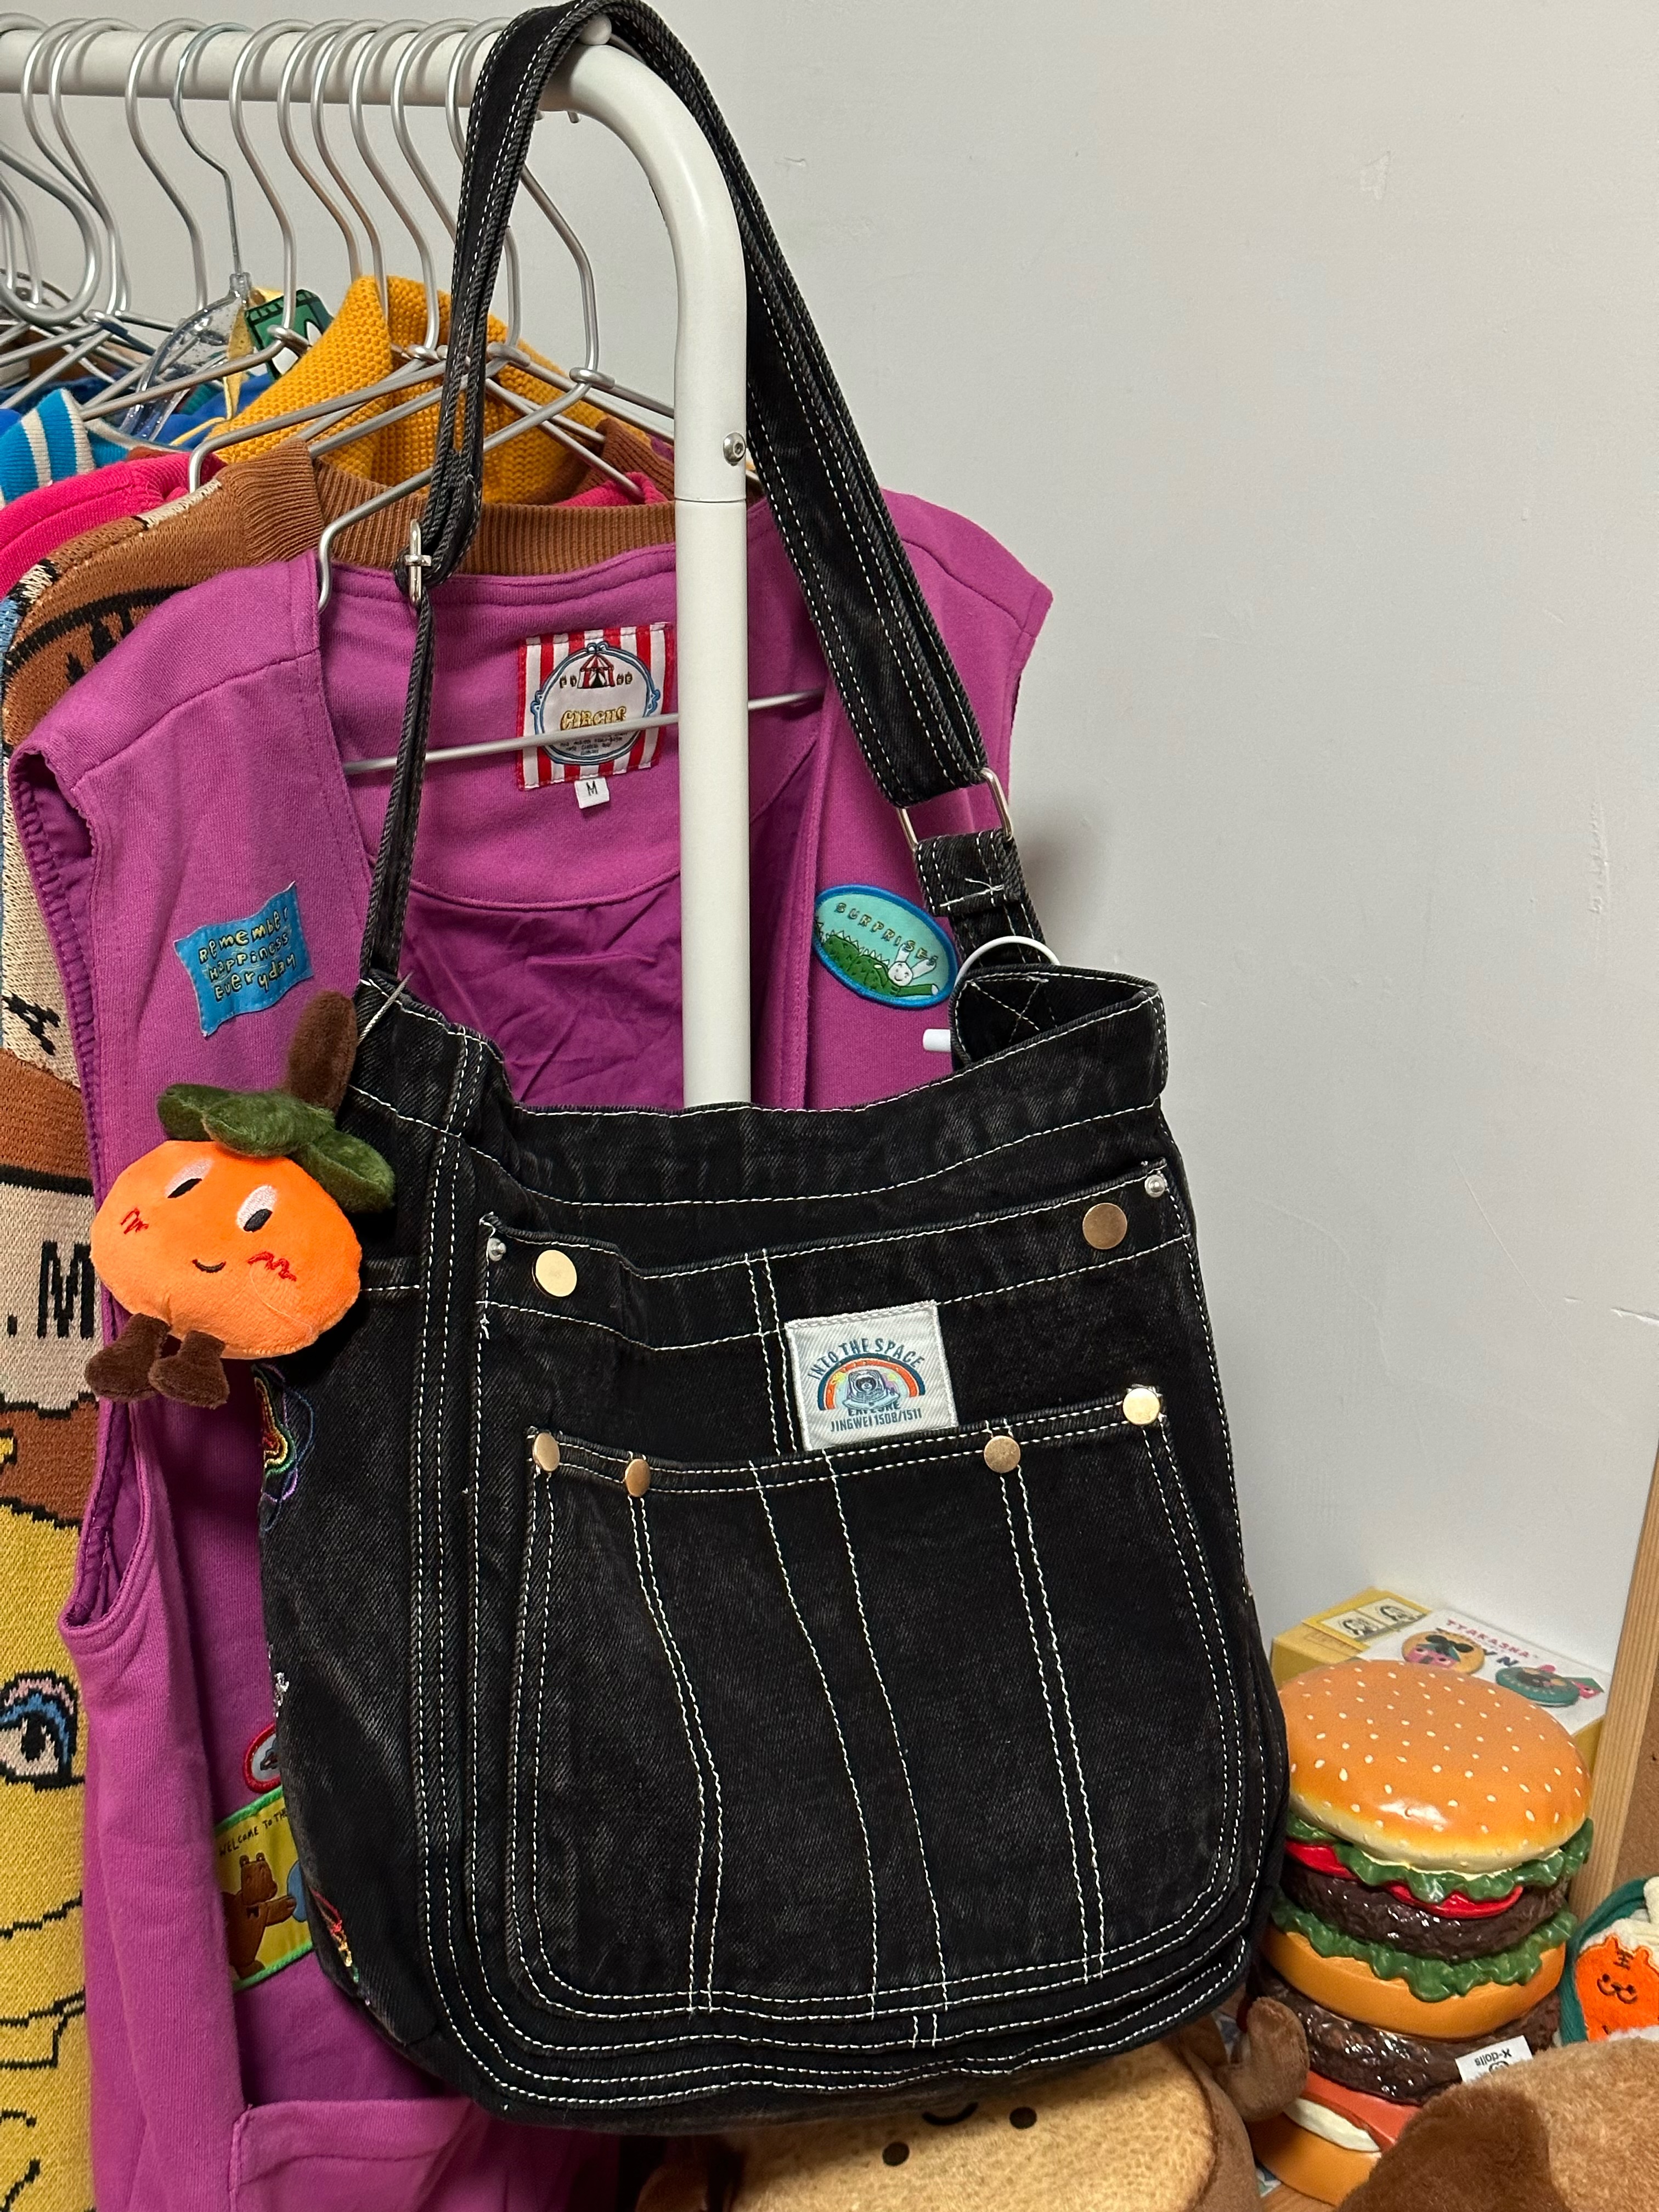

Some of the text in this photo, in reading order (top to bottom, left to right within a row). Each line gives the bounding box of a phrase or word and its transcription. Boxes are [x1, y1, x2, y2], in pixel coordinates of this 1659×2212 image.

[585, 781, 599, 796] M
[807, 1338, 926, 1380] INTO THE SPACE
[830, 1408, 922, 1432] JINGWEI 1508/1511
[219, 1826, 259, 1856] WELCOME
[262, 1819, 273, 1830] TO
